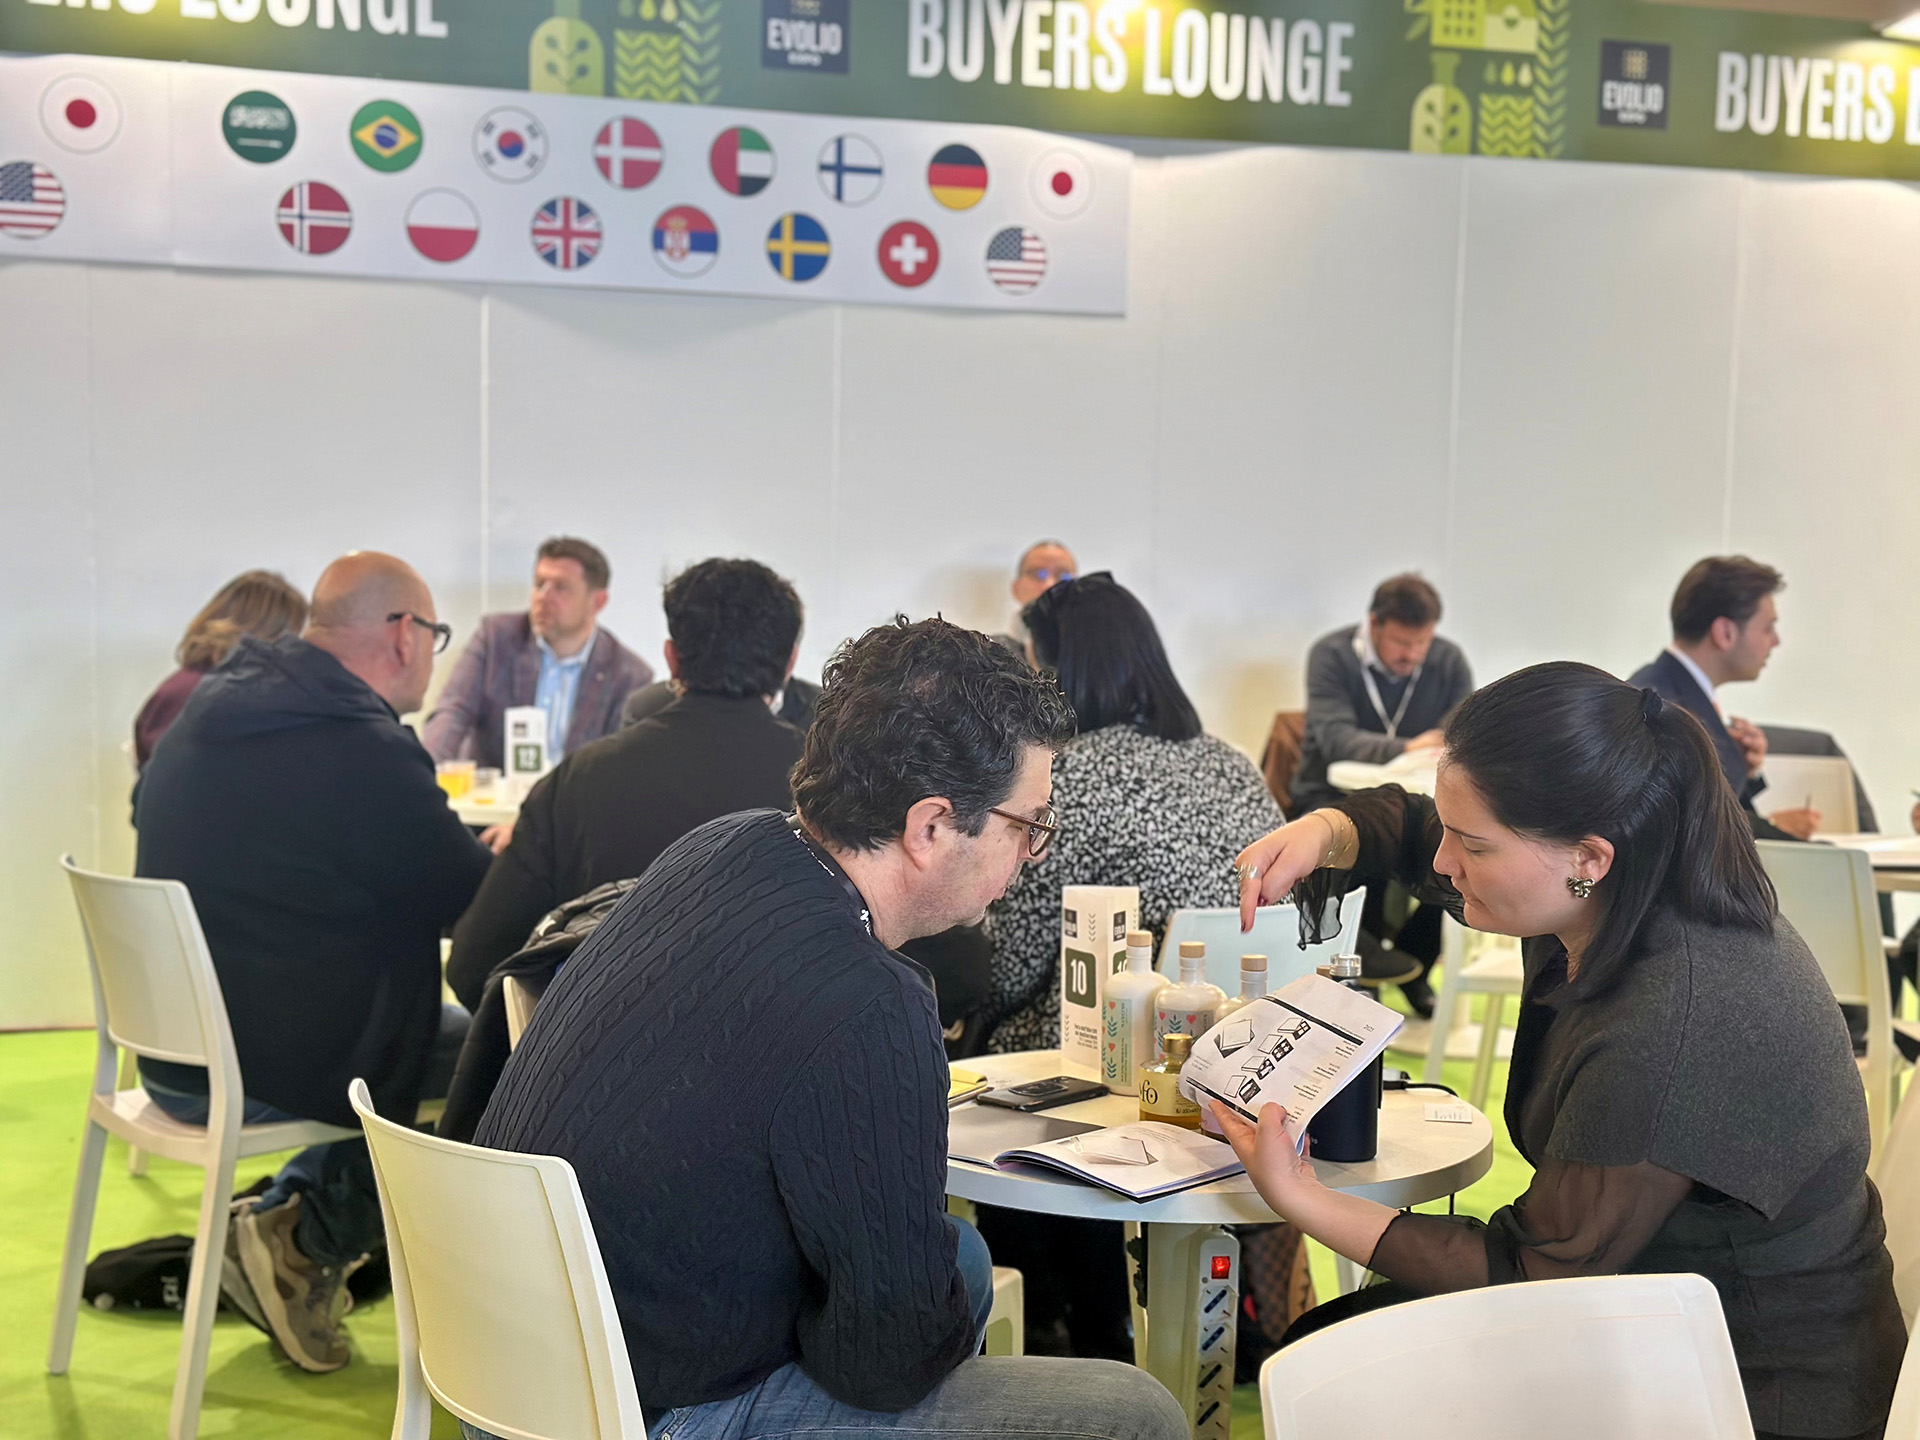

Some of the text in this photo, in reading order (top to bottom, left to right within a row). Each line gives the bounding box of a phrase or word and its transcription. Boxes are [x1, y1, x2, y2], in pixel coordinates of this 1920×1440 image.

[767, 18, 843, 55] EVOLIO
[907, 0, 1355, 107] BUYERS LOUNGE
[1714, 51, 1896, 145] BUYERS
[1070, 959, 1087, 995] 10
